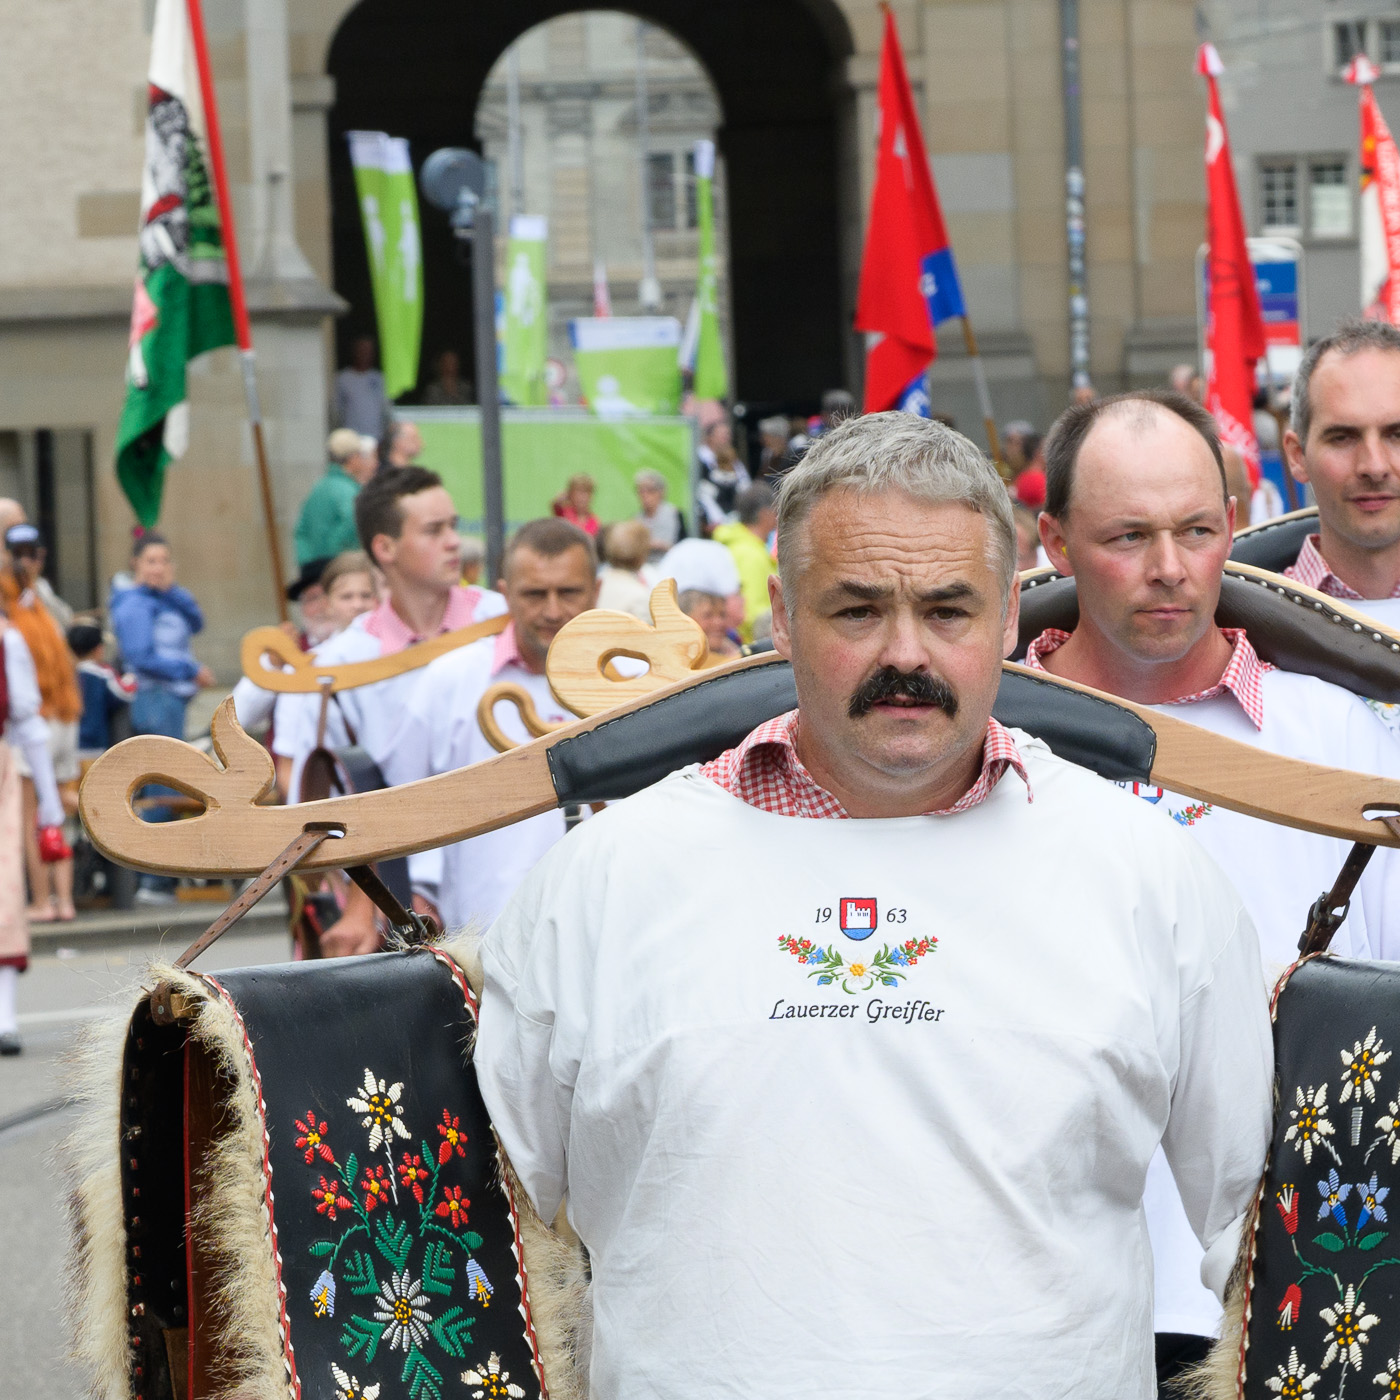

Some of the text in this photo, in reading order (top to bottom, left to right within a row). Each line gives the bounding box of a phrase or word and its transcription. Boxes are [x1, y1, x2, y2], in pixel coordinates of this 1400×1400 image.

[814, 907, 908, 924] 19 63
[768, 998, 945, 1025] Lauerzer Greifler
